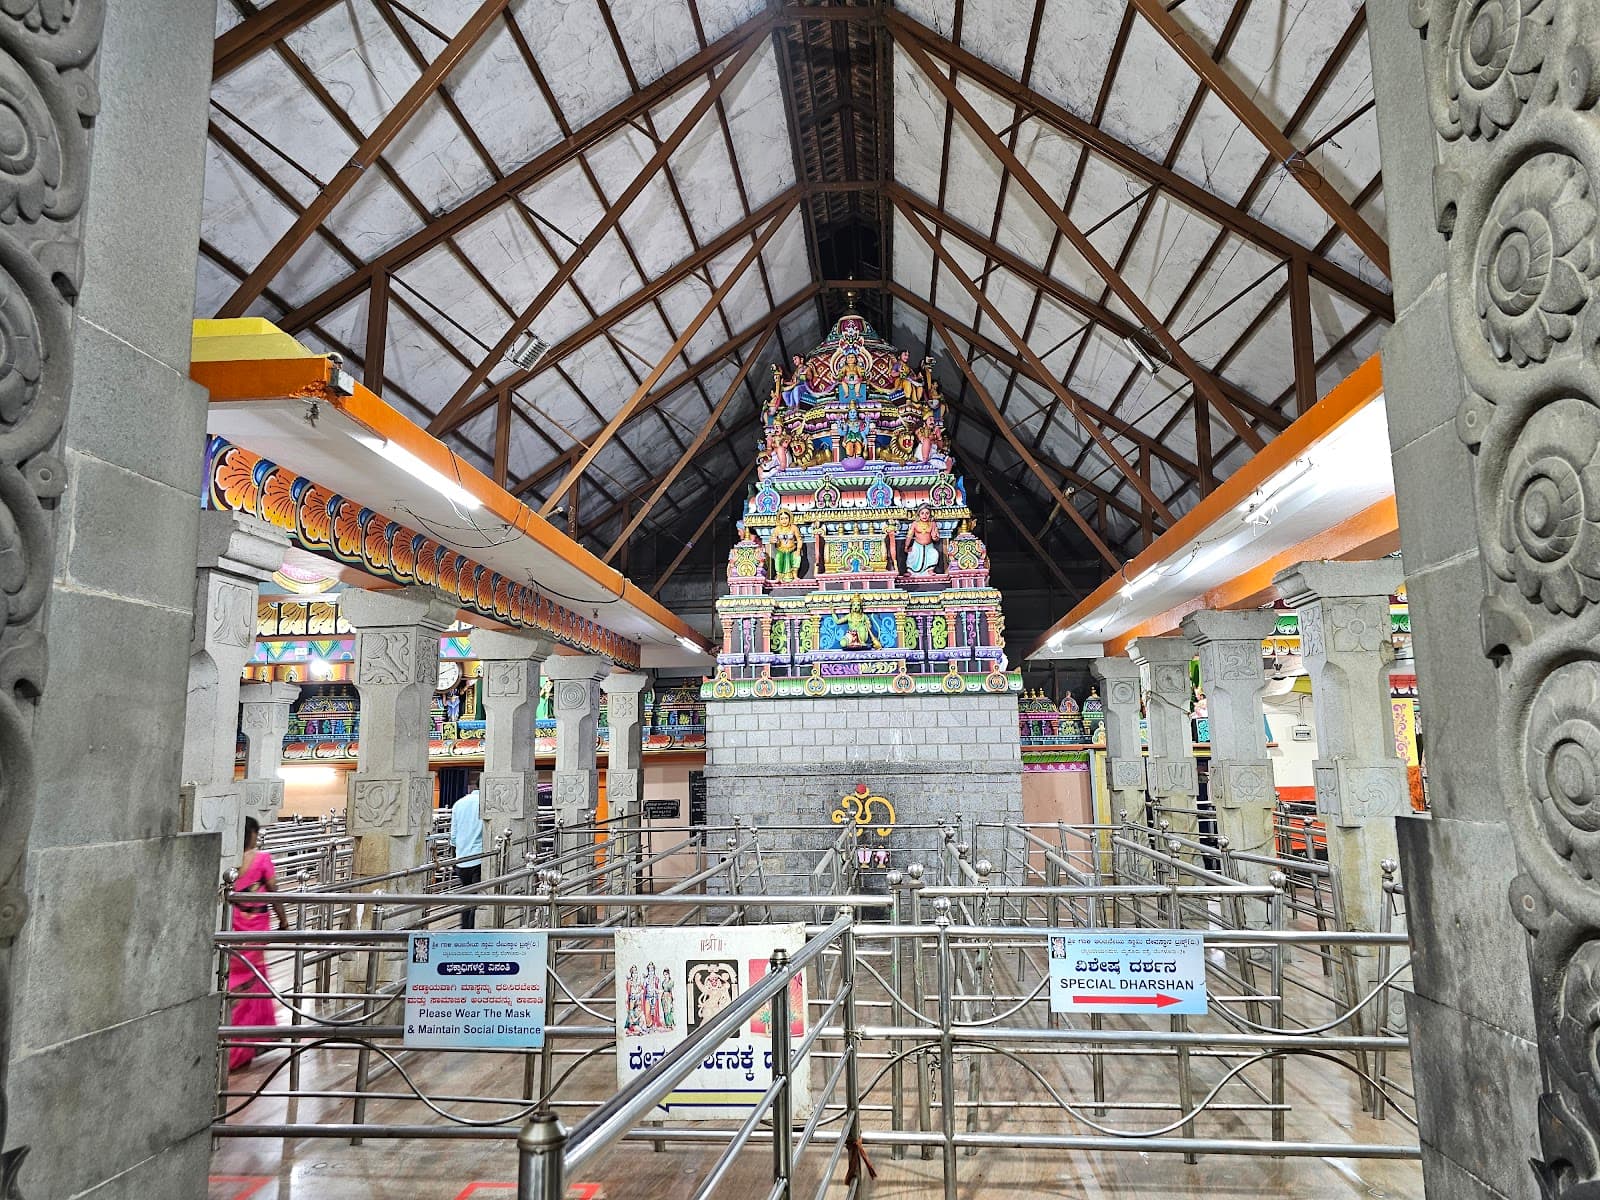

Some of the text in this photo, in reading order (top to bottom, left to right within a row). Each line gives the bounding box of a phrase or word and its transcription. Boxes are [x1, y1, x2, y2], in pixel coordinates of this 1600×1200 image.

[488, 963, 511, 972] ವಿನಂತಿ
[1075, 957, 1177, 975] ವಿಶೇಷ ದರ್ಶನ
[1060, 978, 1194, 990] SPECIAL DHARSHAN
[419, 1008, 531, 1018] Please Wear The Mask
[407, 1024, 541, 1034] & Maintain Social Distance
